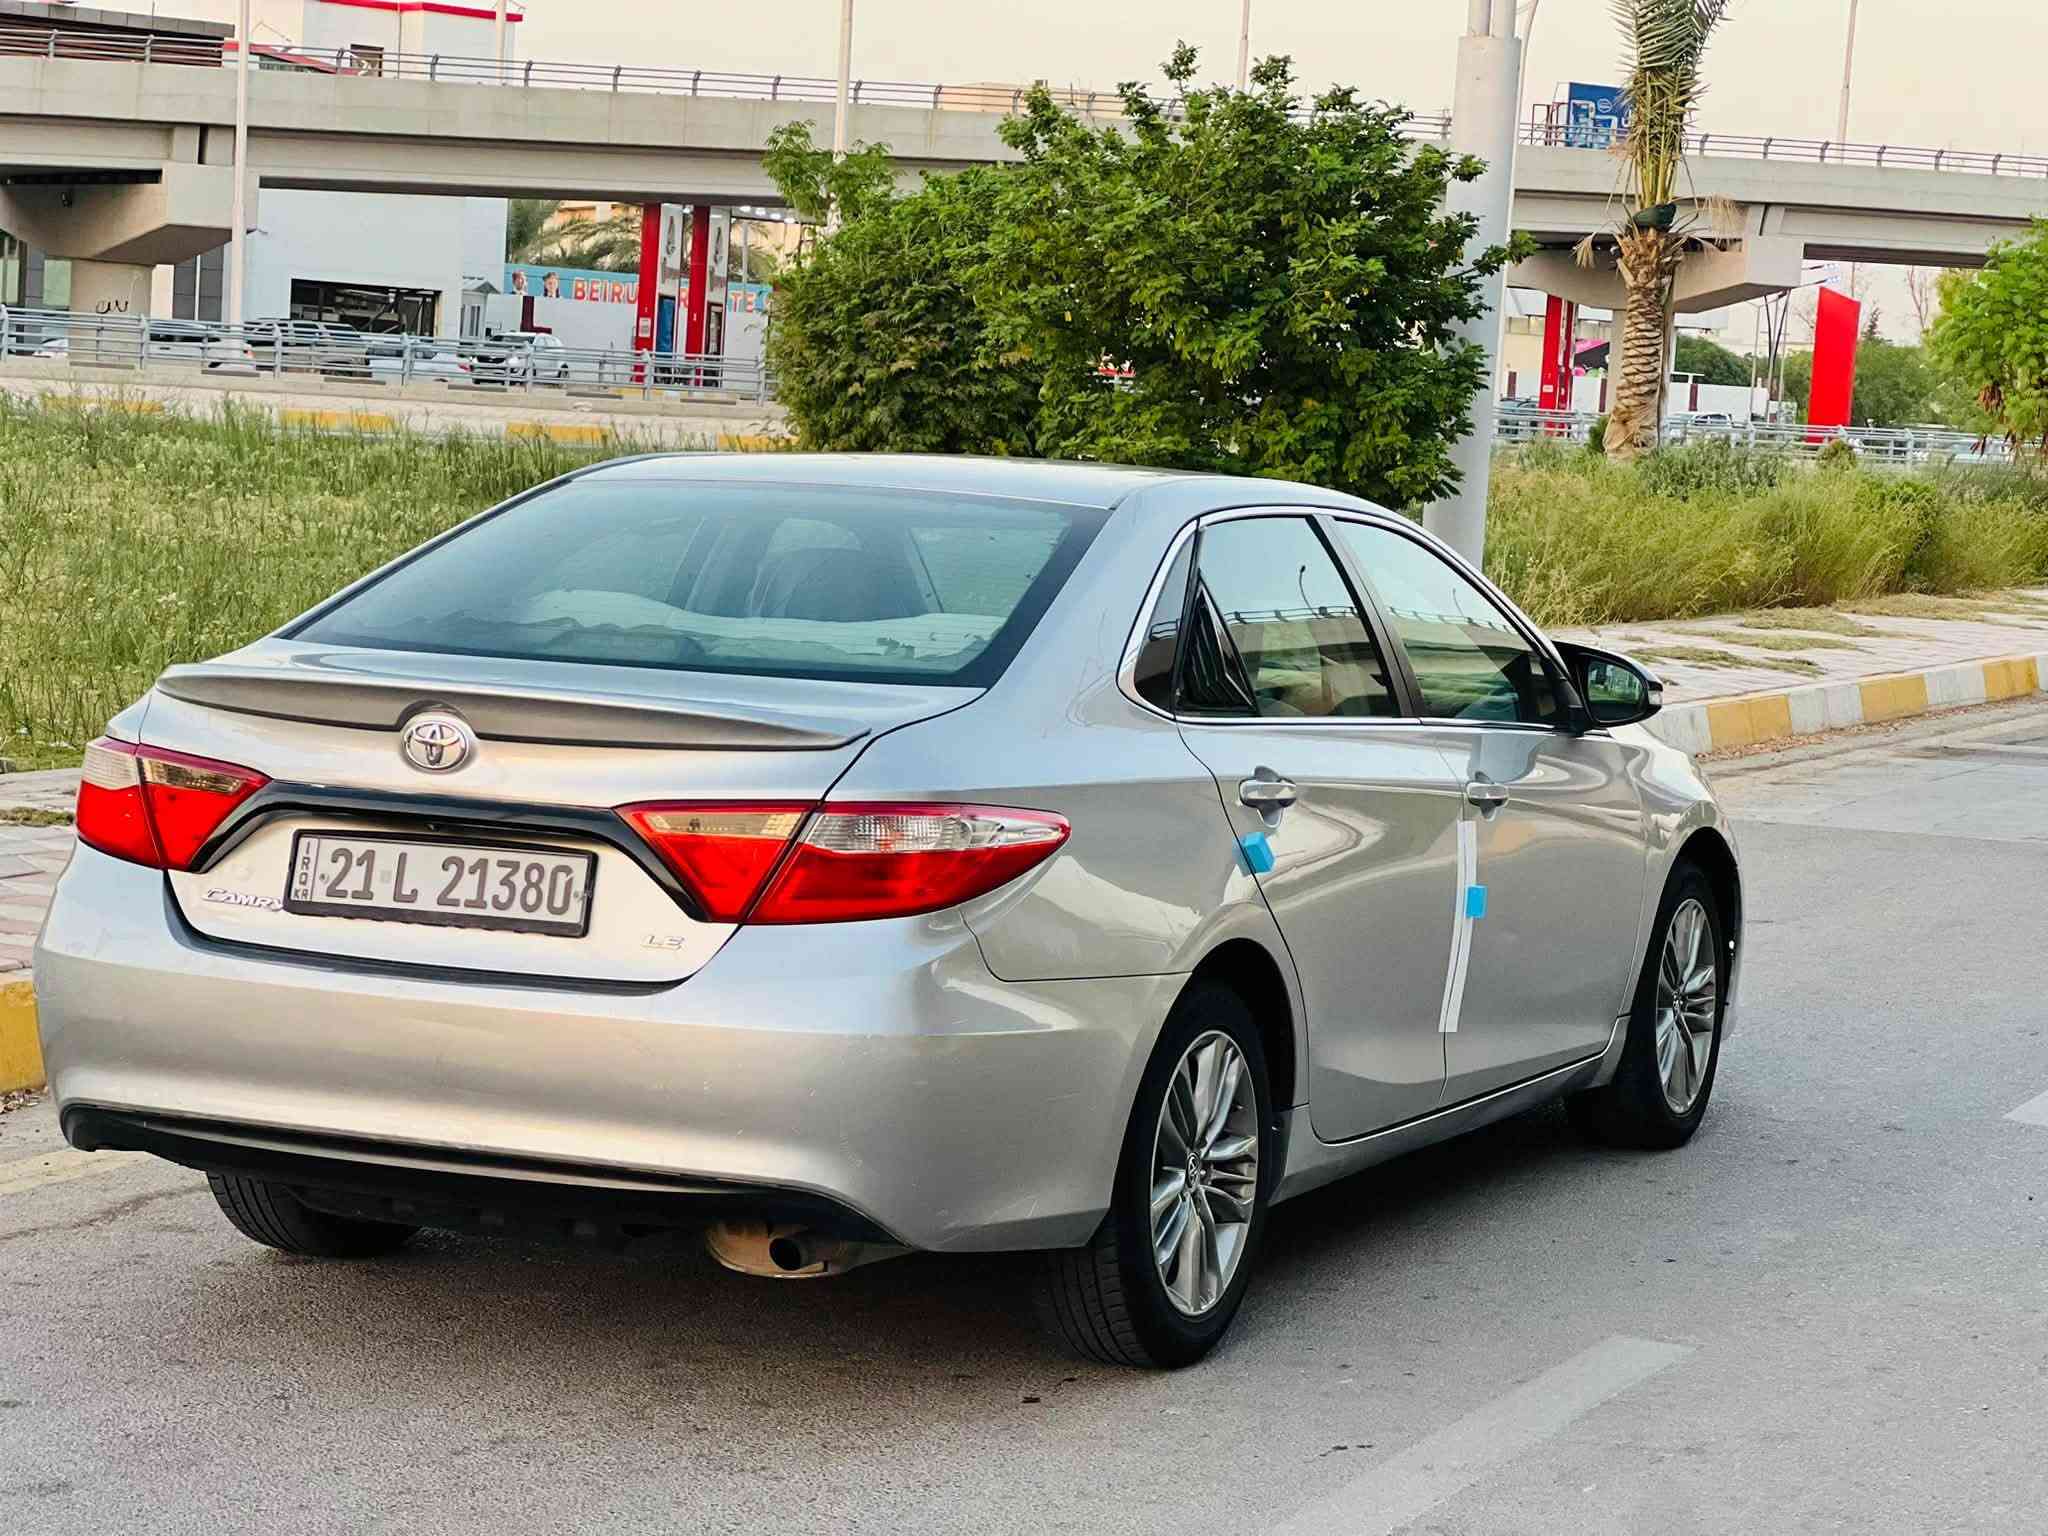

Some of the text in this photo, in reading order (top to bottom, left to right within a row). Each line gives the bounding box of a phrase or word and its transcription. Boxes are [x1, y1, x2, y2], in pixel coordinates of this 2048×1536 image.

[325, 847, 574, 916] 21 L 21380
